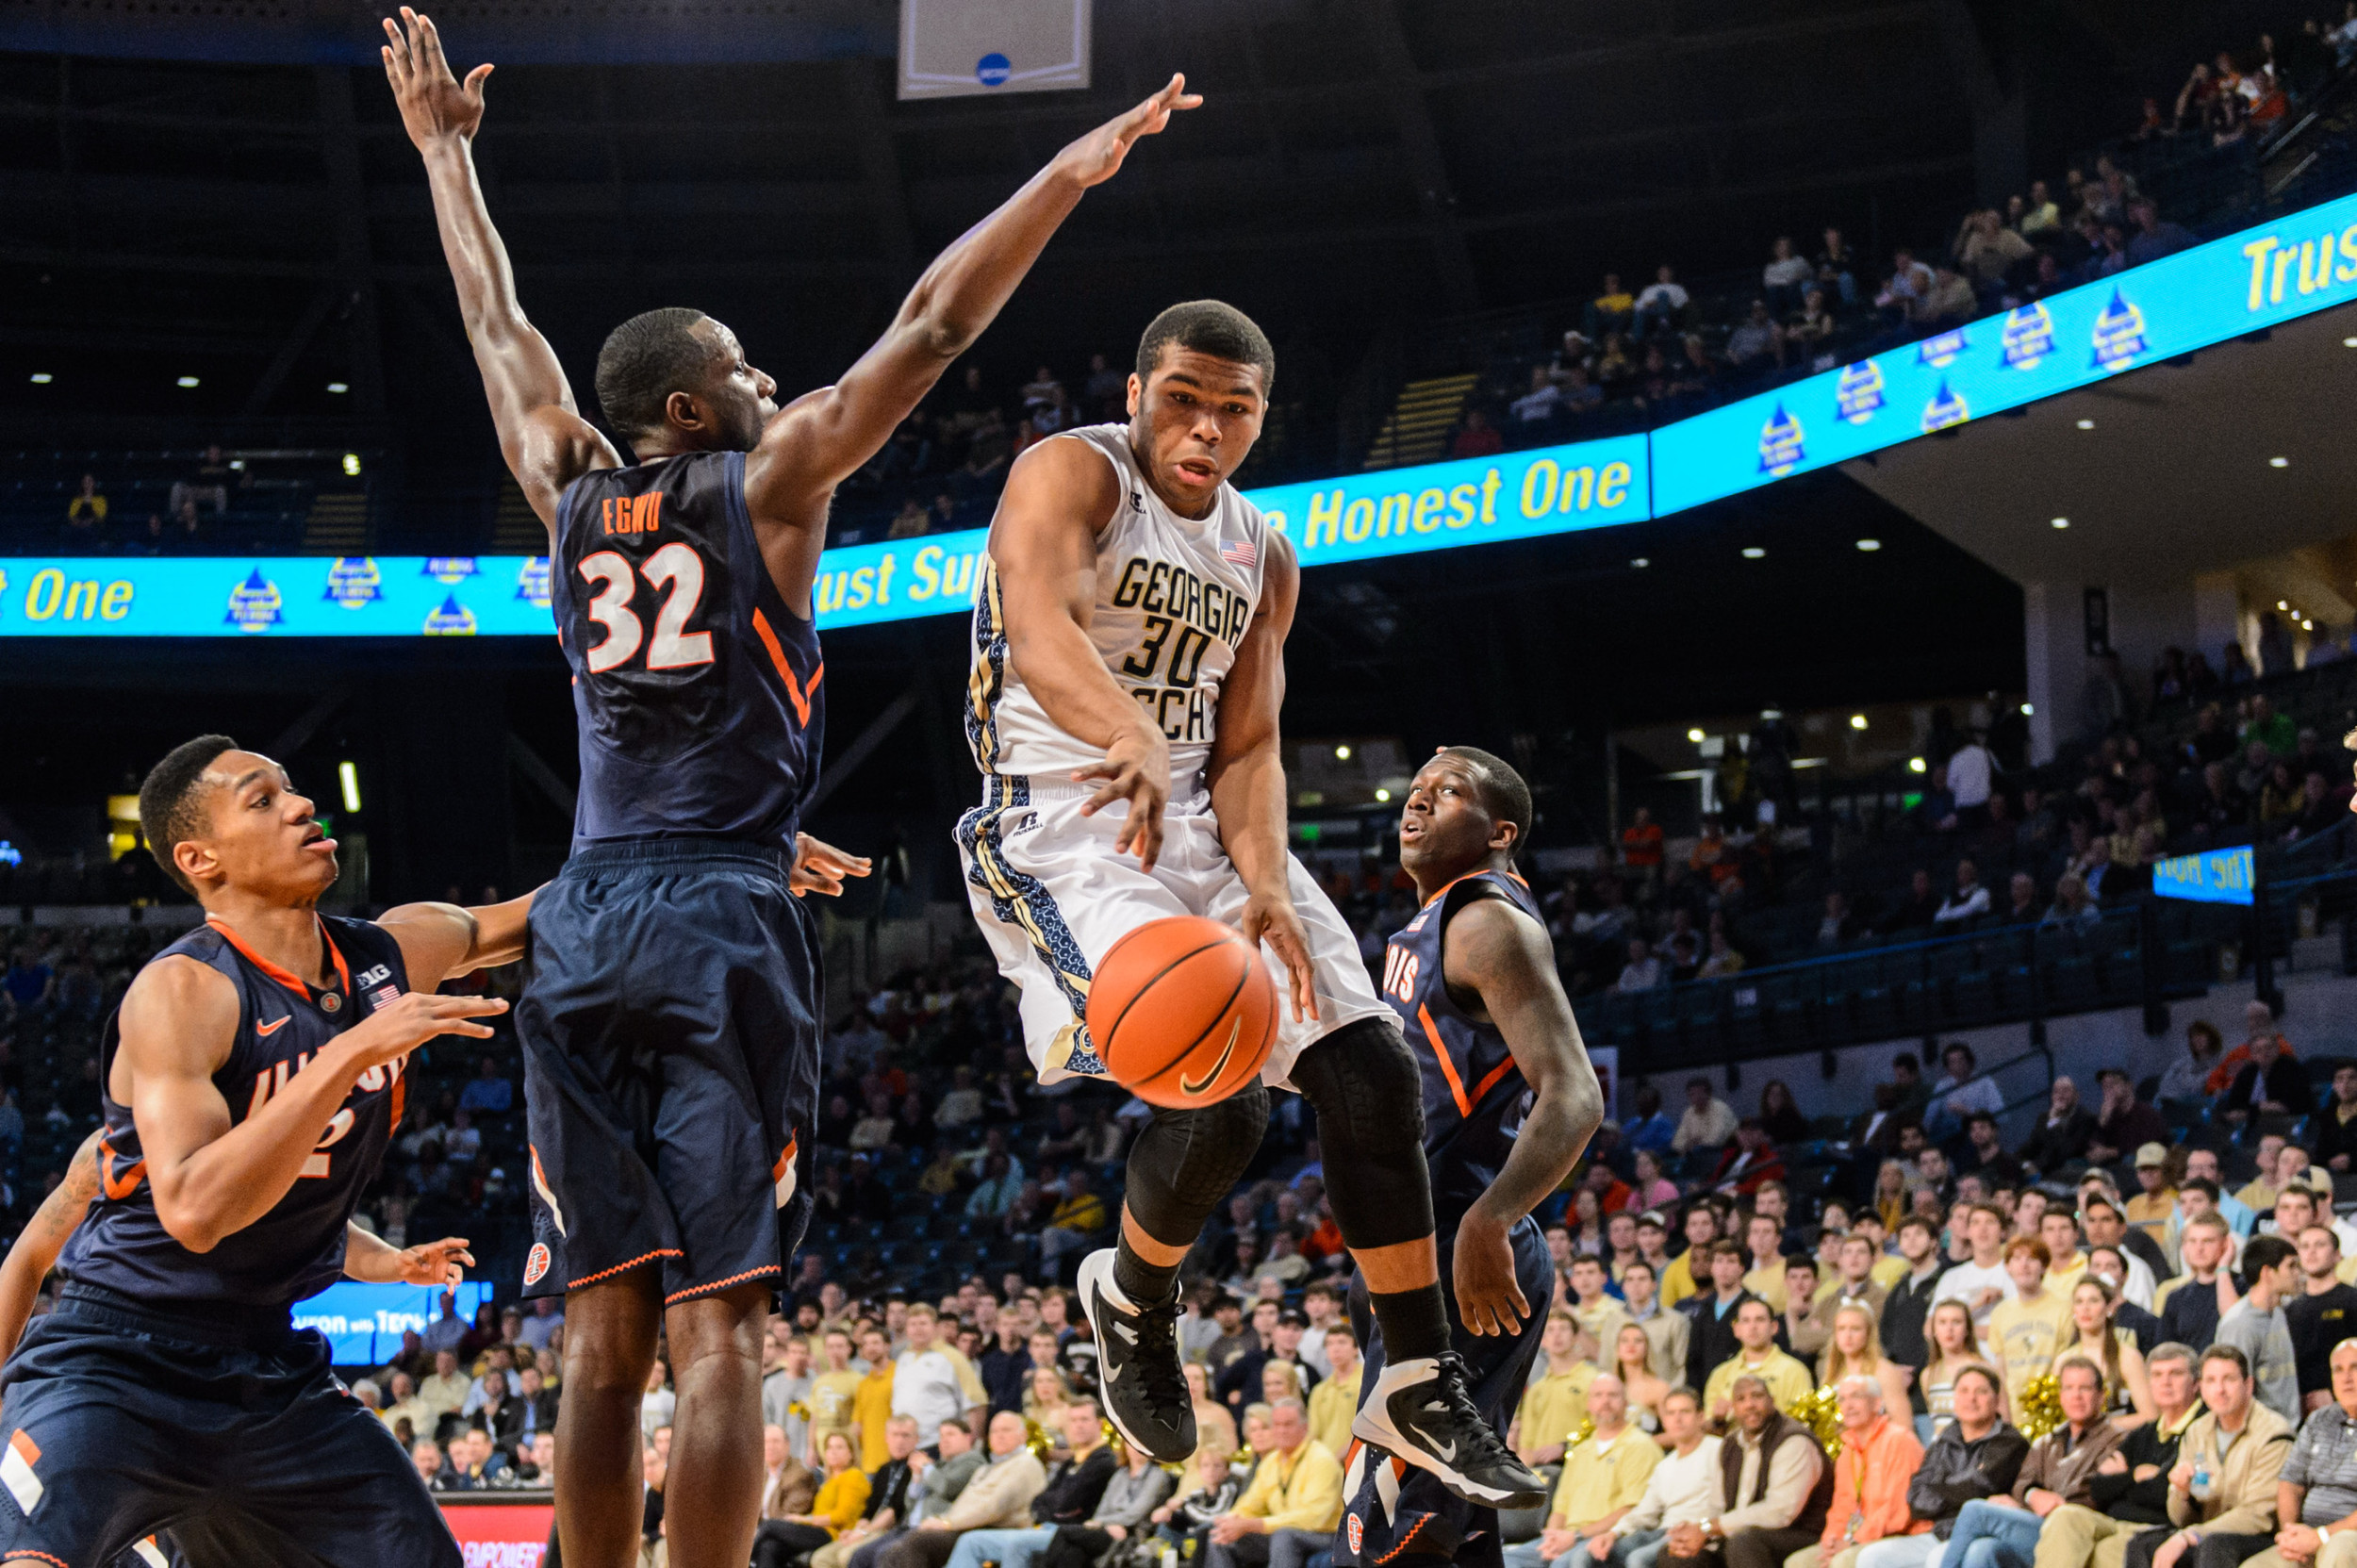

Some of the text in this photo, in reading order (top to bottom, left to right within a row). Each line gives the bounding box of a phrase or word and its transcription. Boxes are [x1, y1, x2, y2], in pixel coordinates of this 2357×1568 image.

[1304, 458, 1632, 548] Honest One
[25, 568, 134, 621] One
[578, 542, 715, 674] 32
[813, 553, 895, 613] ust
[1113, 557, 1248, 652] GEORGIA
[1122, 615, 1211, 689] 30
